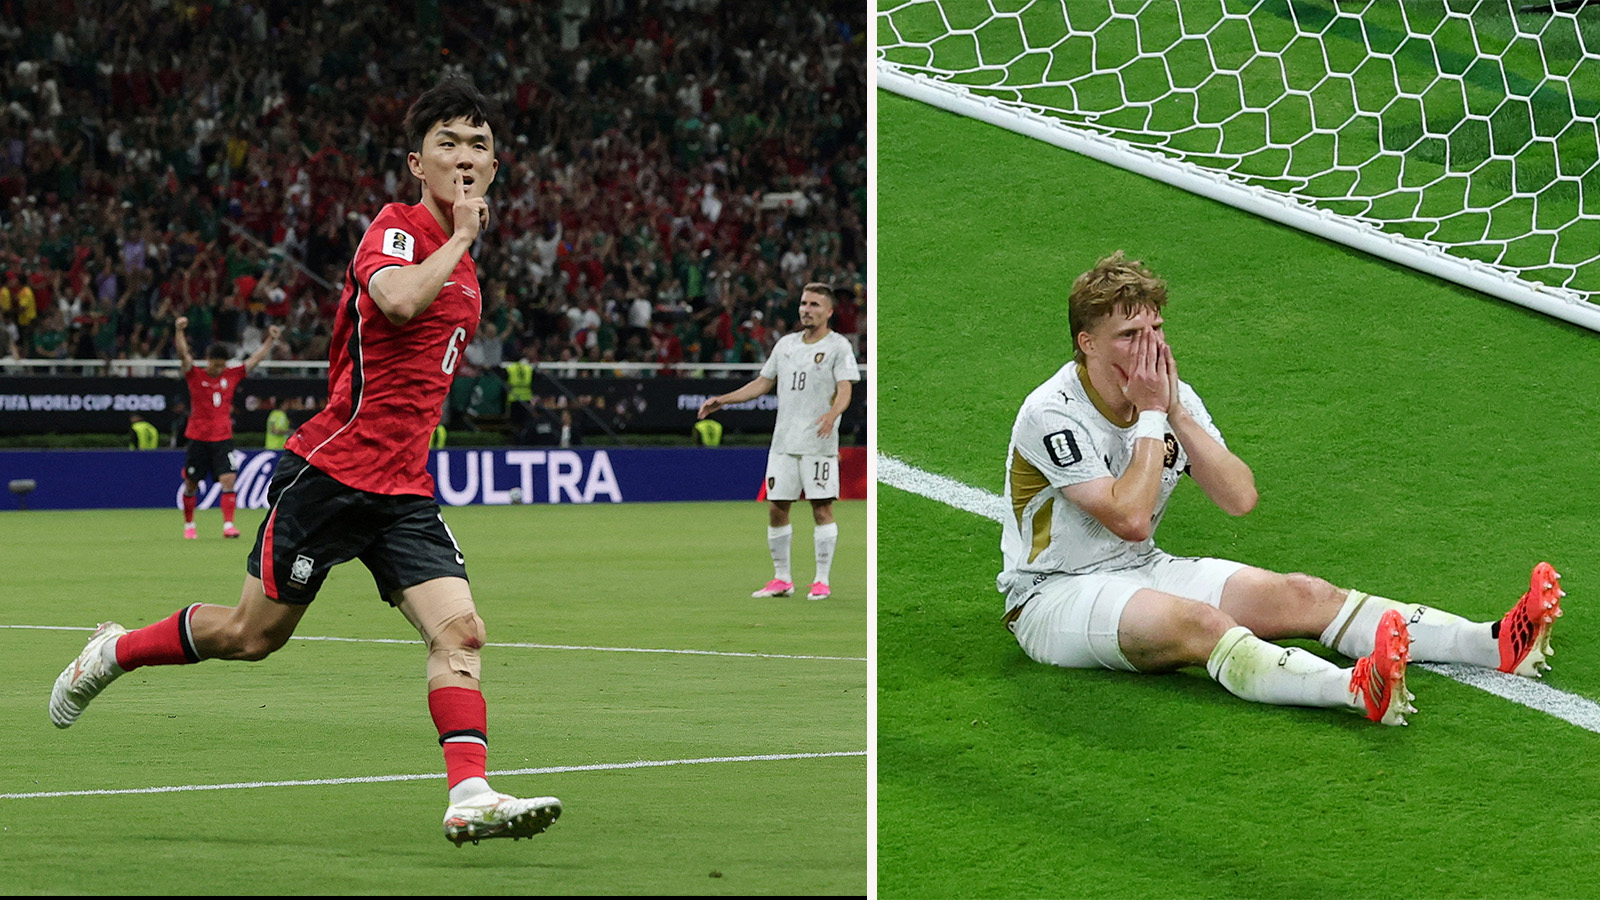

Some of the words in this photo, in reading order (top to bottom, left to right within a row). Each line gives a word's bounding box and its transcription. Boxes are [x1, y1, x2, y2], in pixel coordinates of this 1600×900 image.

[441, 326, 466, 375] 6
[790, 371, 806, 391] 18
[29, 394, 82, 411] WORLD
[82, 394, 113, 411] CUP
[113, 394, 166, 411] 2026
[437, 450, 623, 506] ULTRA
[813, 461, 830, 481] 18
